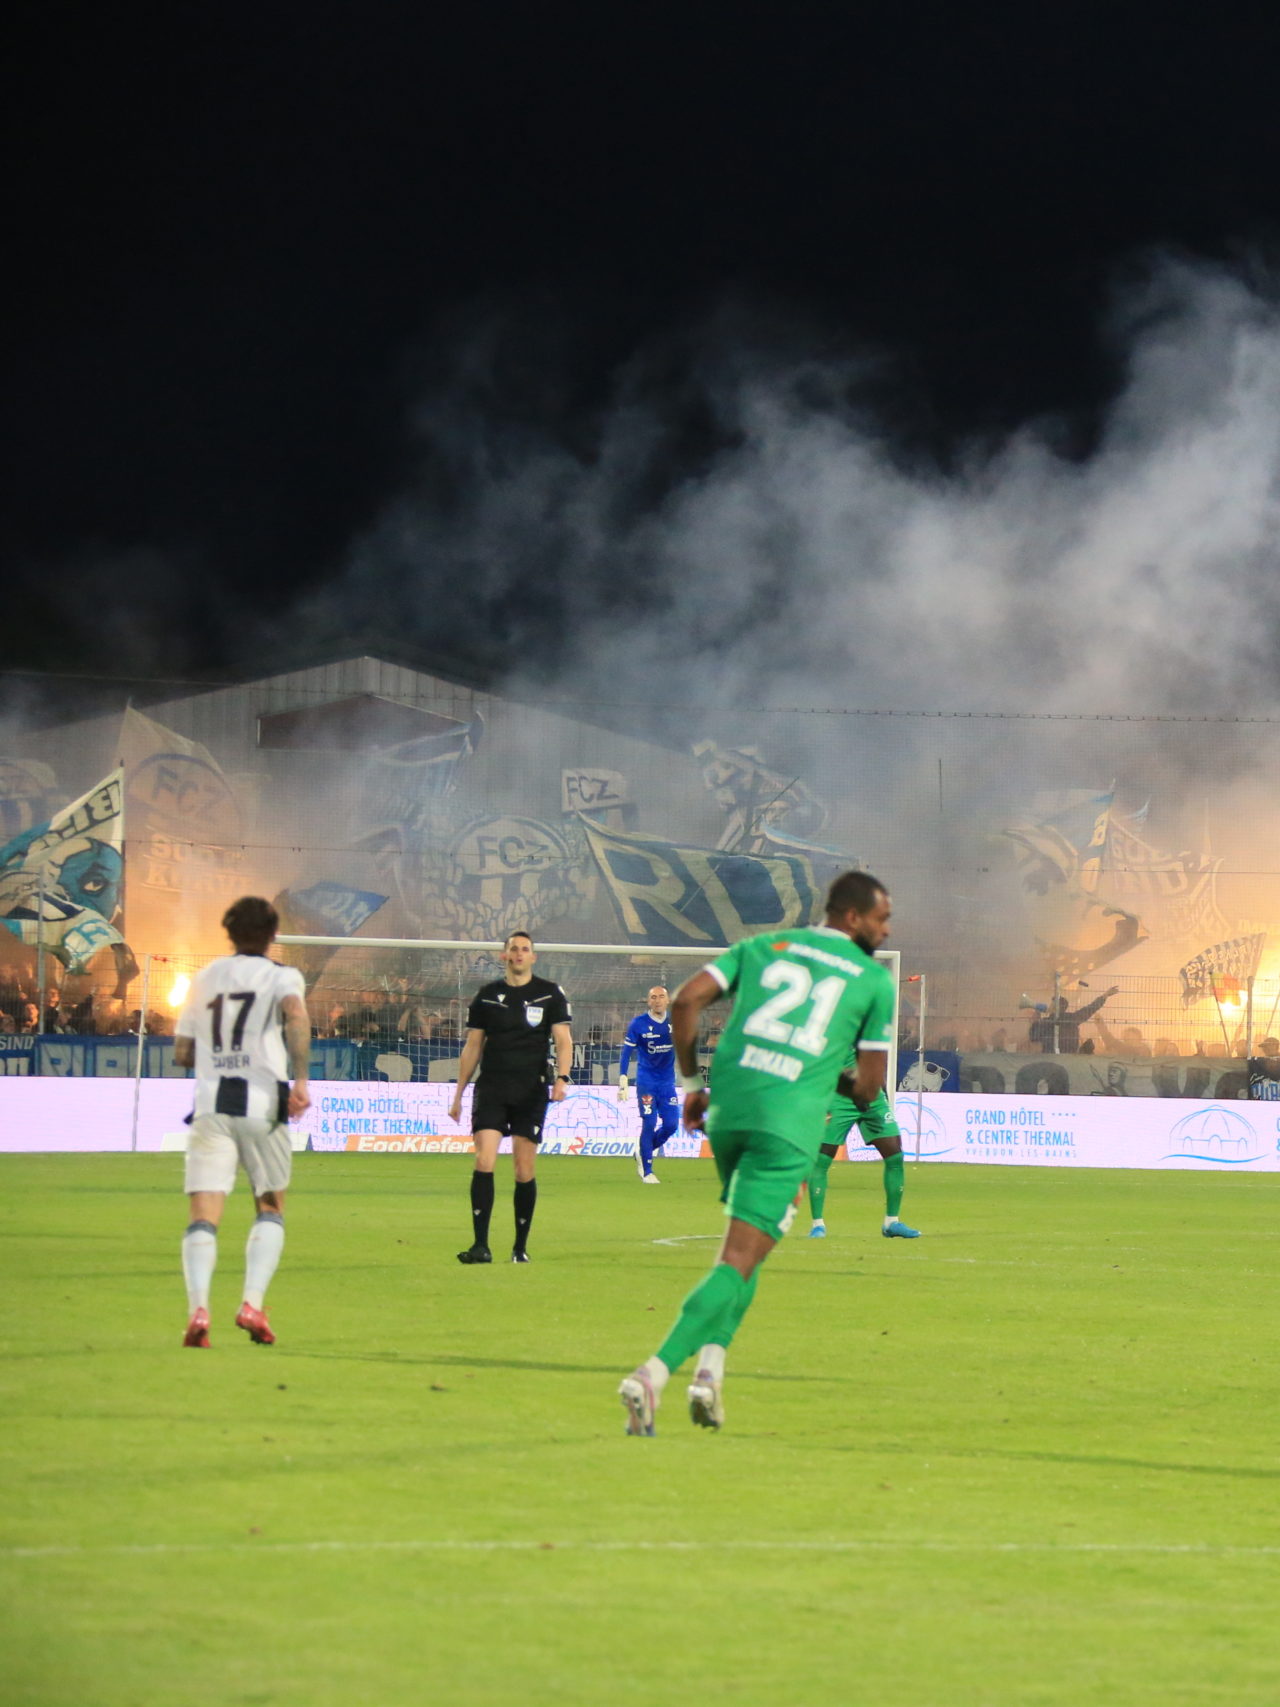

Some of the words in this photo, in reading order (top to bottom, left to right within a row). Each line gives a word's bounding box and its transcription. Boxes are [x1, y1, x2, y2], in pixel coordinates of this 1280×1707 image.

[567, 775, 619, 808] FCZ
[477, 836, 549, 868] FCZ
[743, 959, 847, 1056] 21
[207, 991, 256, 1053] 17
[322, 1097, 364, 1113] GRAND
[368, 1095, 406, 1113] HÔTEL
[966, 1110, 1006, 1125] GRAND
[1010, 1107, 1046, 1126] HÔTEL
[321, 1119, 330, 1133] &
[334, 1118, 378, 1134] CENTRE
[383, 1119, 438, 1135] THERMAL
[540, 1142, 561, 1155] LA
[568, 1137, 635, 1155] RÉGION
[966, 1130, 974, 1144] &
[977, 1129, 1019, 1145] CENTRE
[1023, 1130, 1075, 1146] THERMAL
